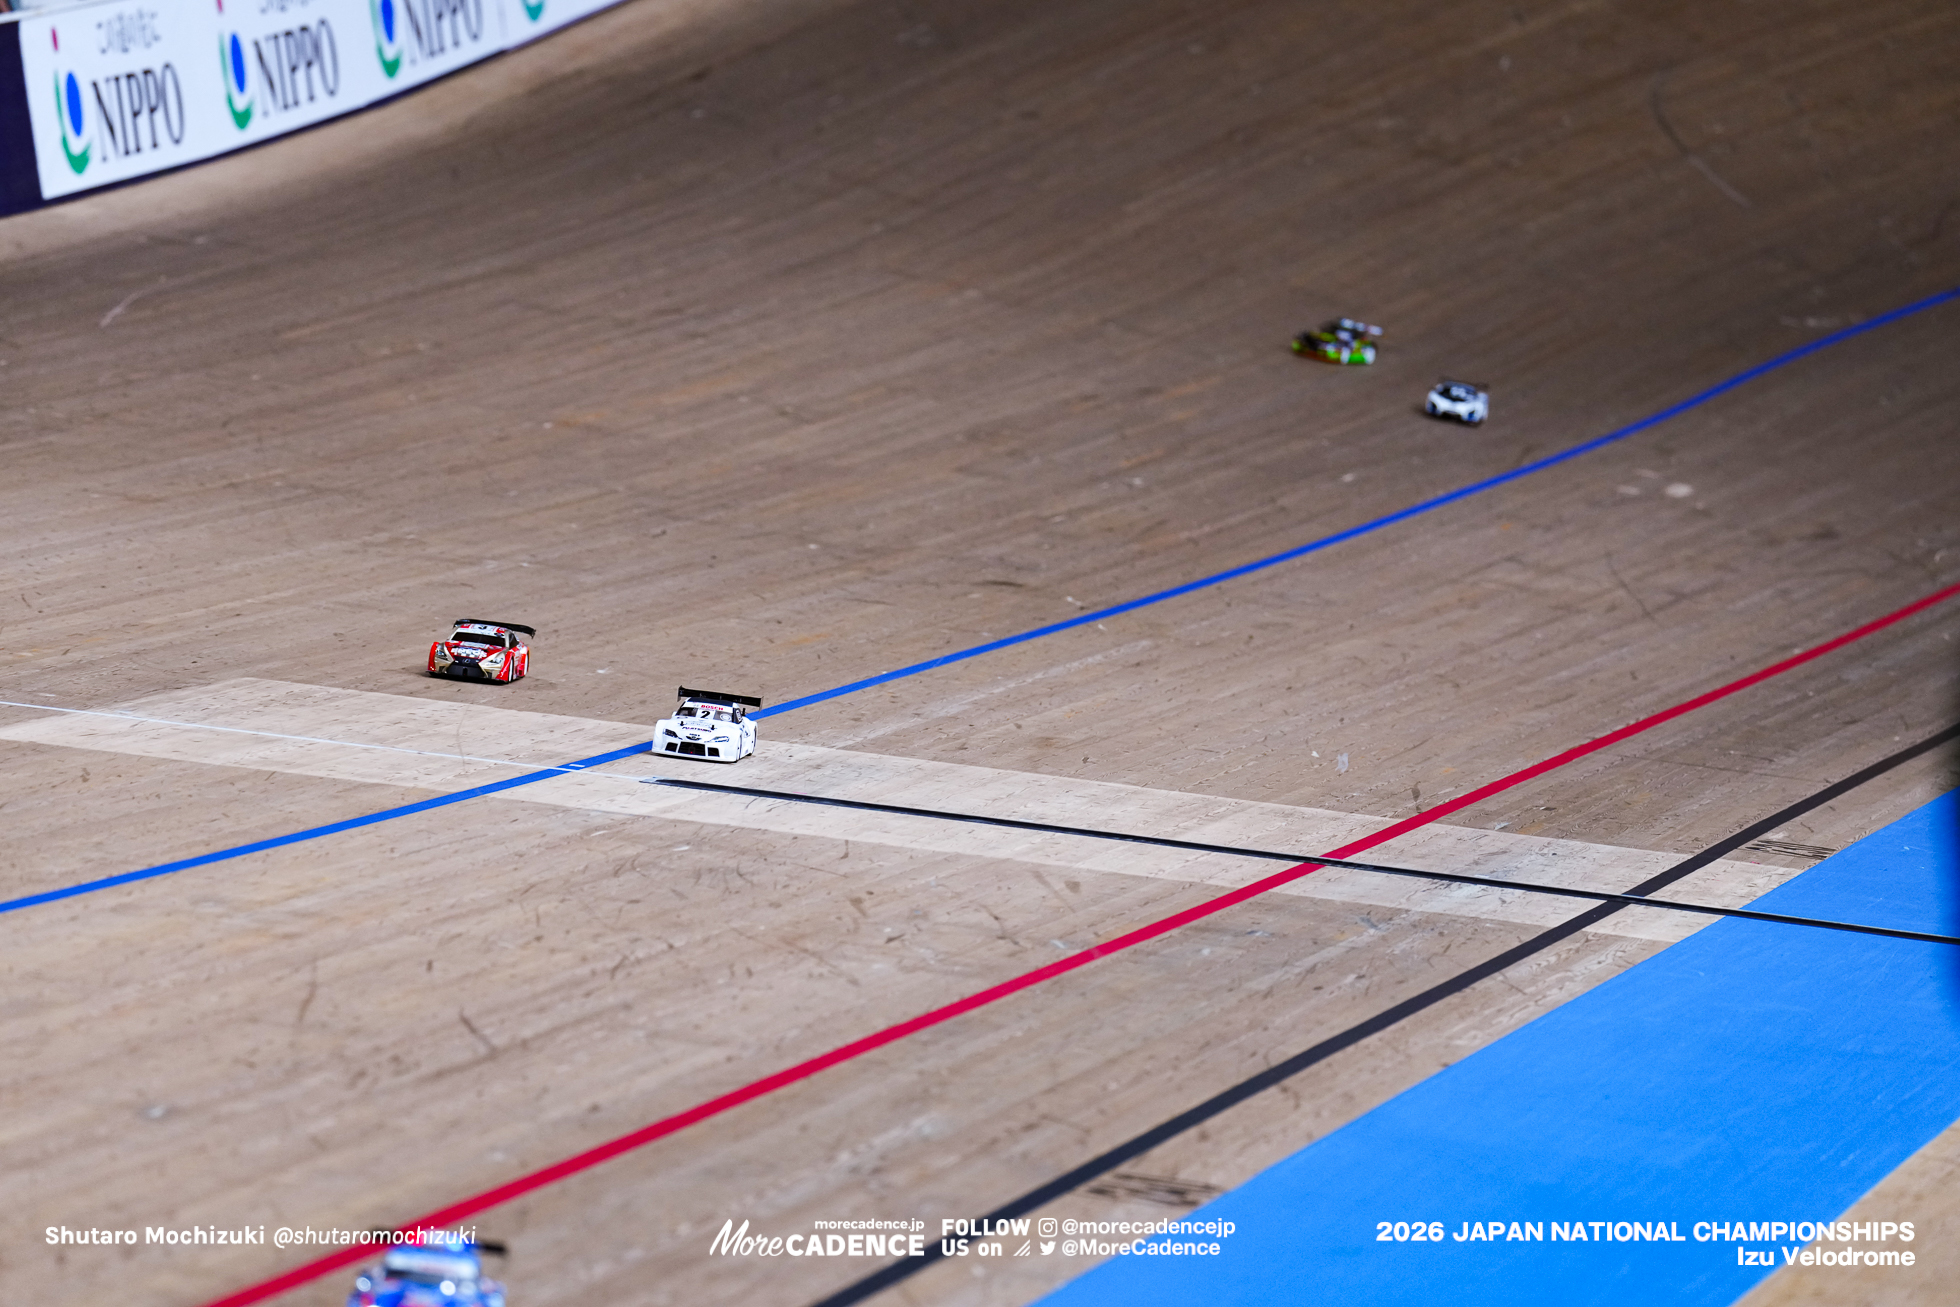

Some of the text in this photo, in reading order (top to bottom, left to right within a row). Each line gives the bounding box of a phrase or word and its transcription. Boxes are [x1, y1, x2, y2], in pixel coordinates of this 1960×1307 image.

[92, 62, 185, 162] NIPPO
[253, 18, 339, 117] NIPPO
[700, 710, 711, 719] 2
